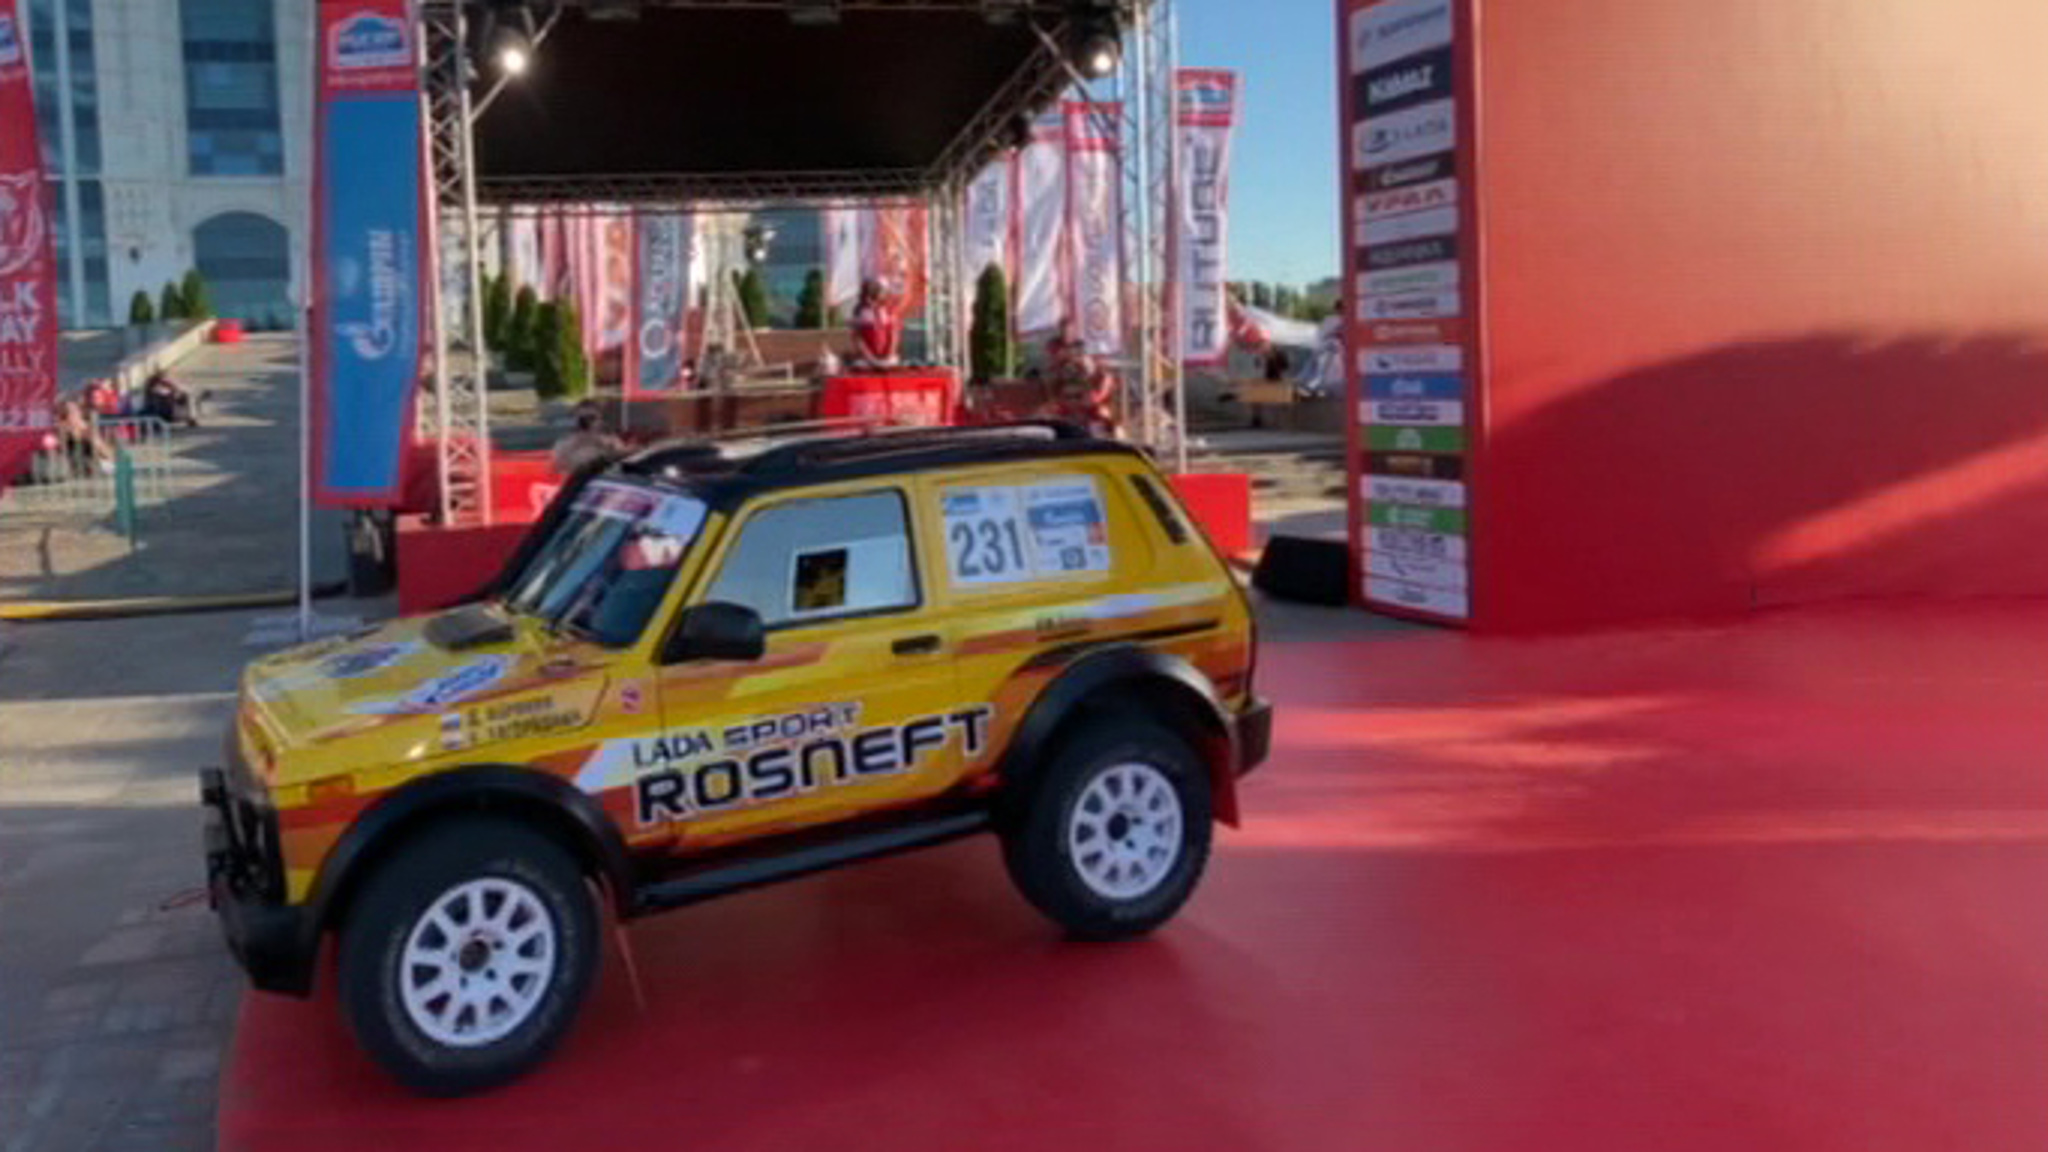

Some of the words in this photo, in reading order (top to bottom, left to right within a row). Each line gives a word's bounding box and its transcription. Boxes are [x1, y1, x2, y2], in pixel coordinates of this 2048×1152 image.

[951, 517, 1026, 578] 231
[631, 730, 713, 769] LADA
[723, 704, 859, 748] SPORT
[636, 707, 992, 825] ROSNEFT
